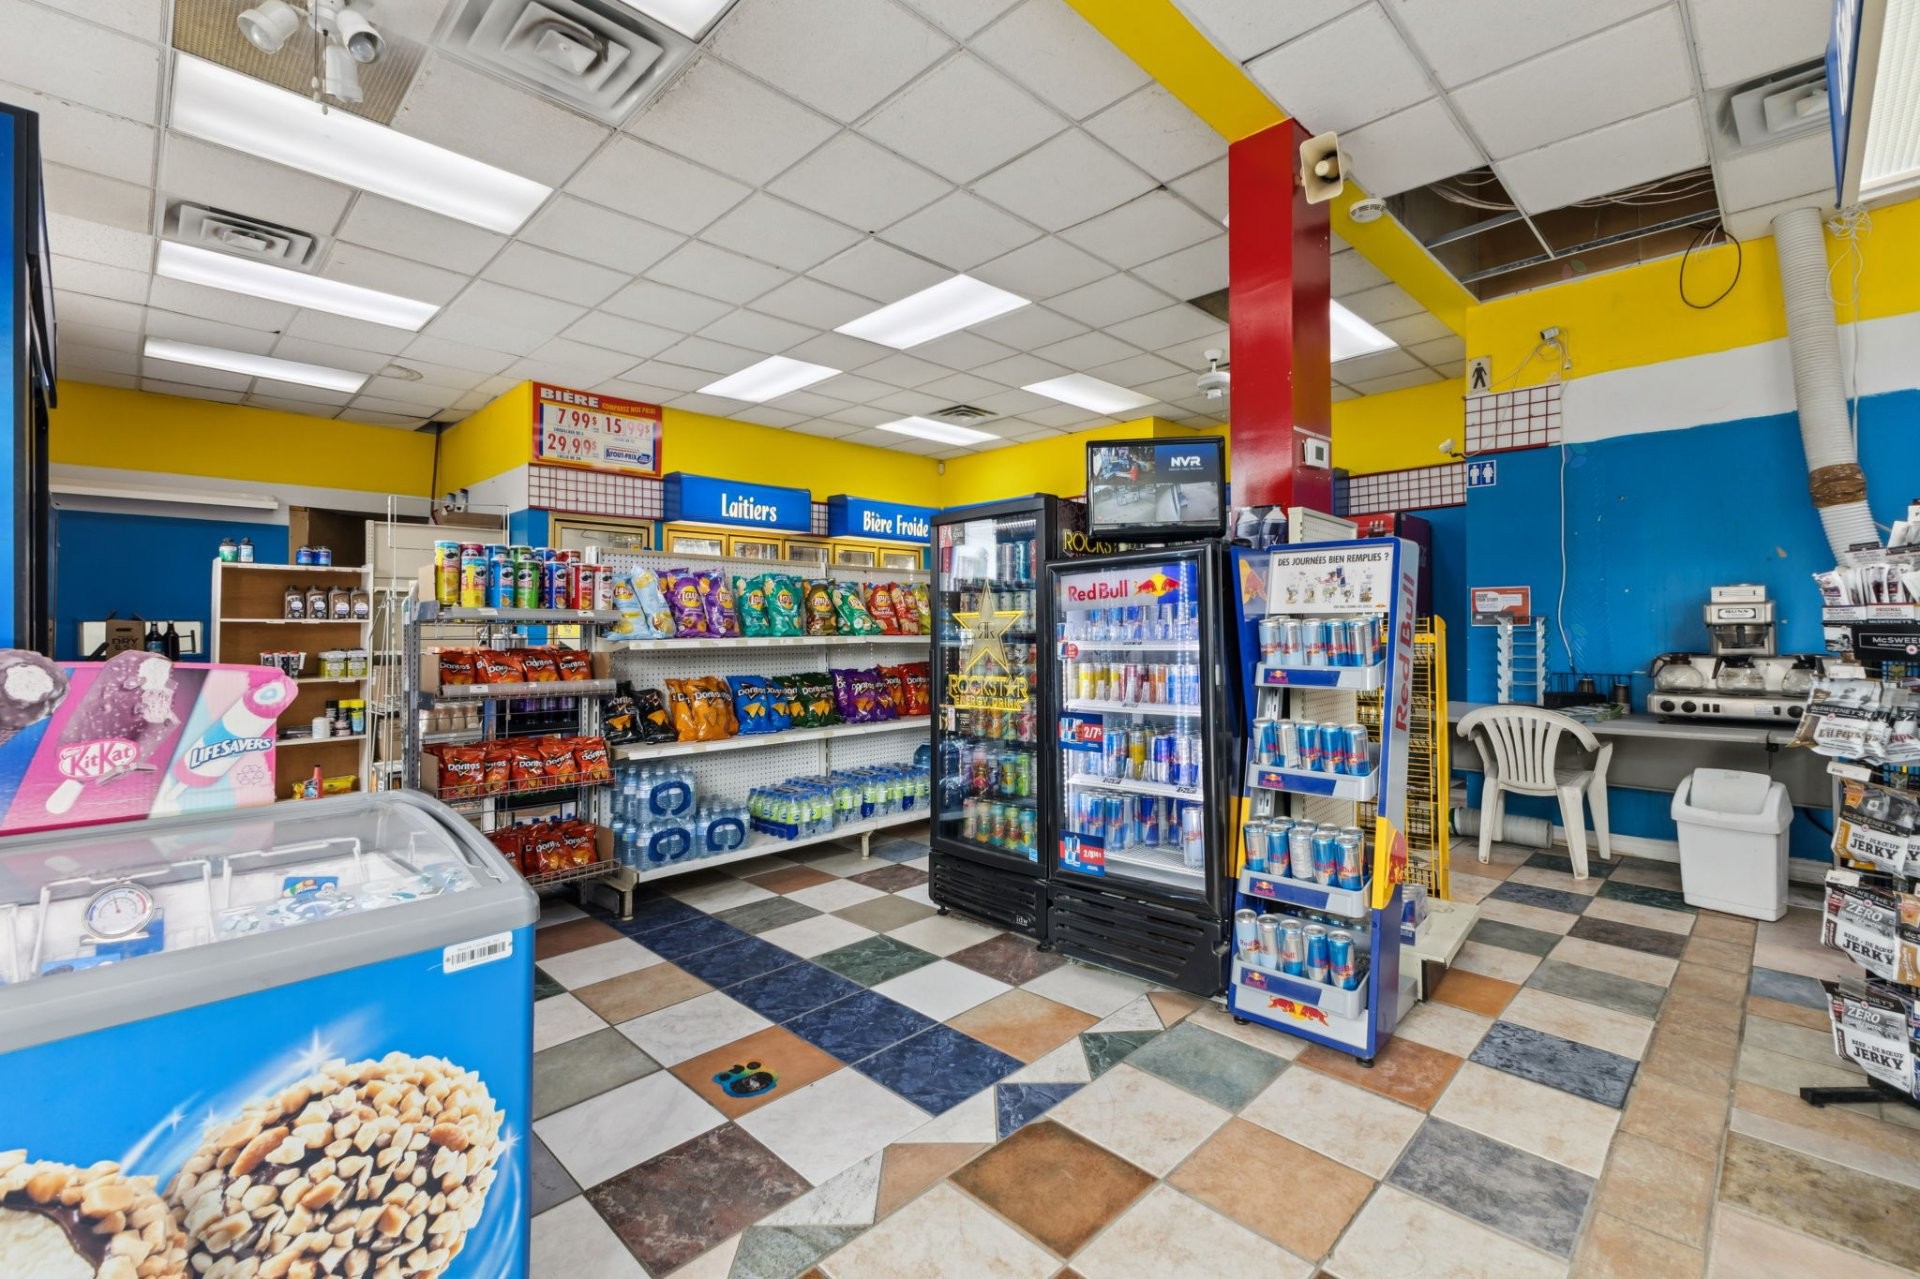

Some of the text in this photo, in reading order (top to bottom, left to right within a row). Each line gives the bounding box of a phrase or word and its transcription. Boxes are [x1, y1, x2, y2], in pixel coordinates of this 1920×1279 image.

[540, 387, 599, 408] BIÈRE
[1170, 456, 1201, 467] NVR
[721, 493, 777, 522] Laitiers
[863, 510, 892, 534] Bière
[896, 514, 929, 538] Froide
[1278, 558, 1290, 567] DES
[1291, 554, 1327, 566] JOURNÉES
[1328, 555, 1345, 564] BIEN
[1346, 553, 1382, 563] REMPLIES
[1068, 580, 1128, 602] Red Bull
[70, 741, 131, 776] KitKat
[447, 762, 480, 771] Doritos
[1850, 839, 1898, 860] JERKY
[1846, 903, 1883, 922] ZERO
[1843, 939, 1894, 965] JERKY
[1848, 1006, 1881, 1024] ZERO
[1854, 1046, 1904, 1070] JERKY
